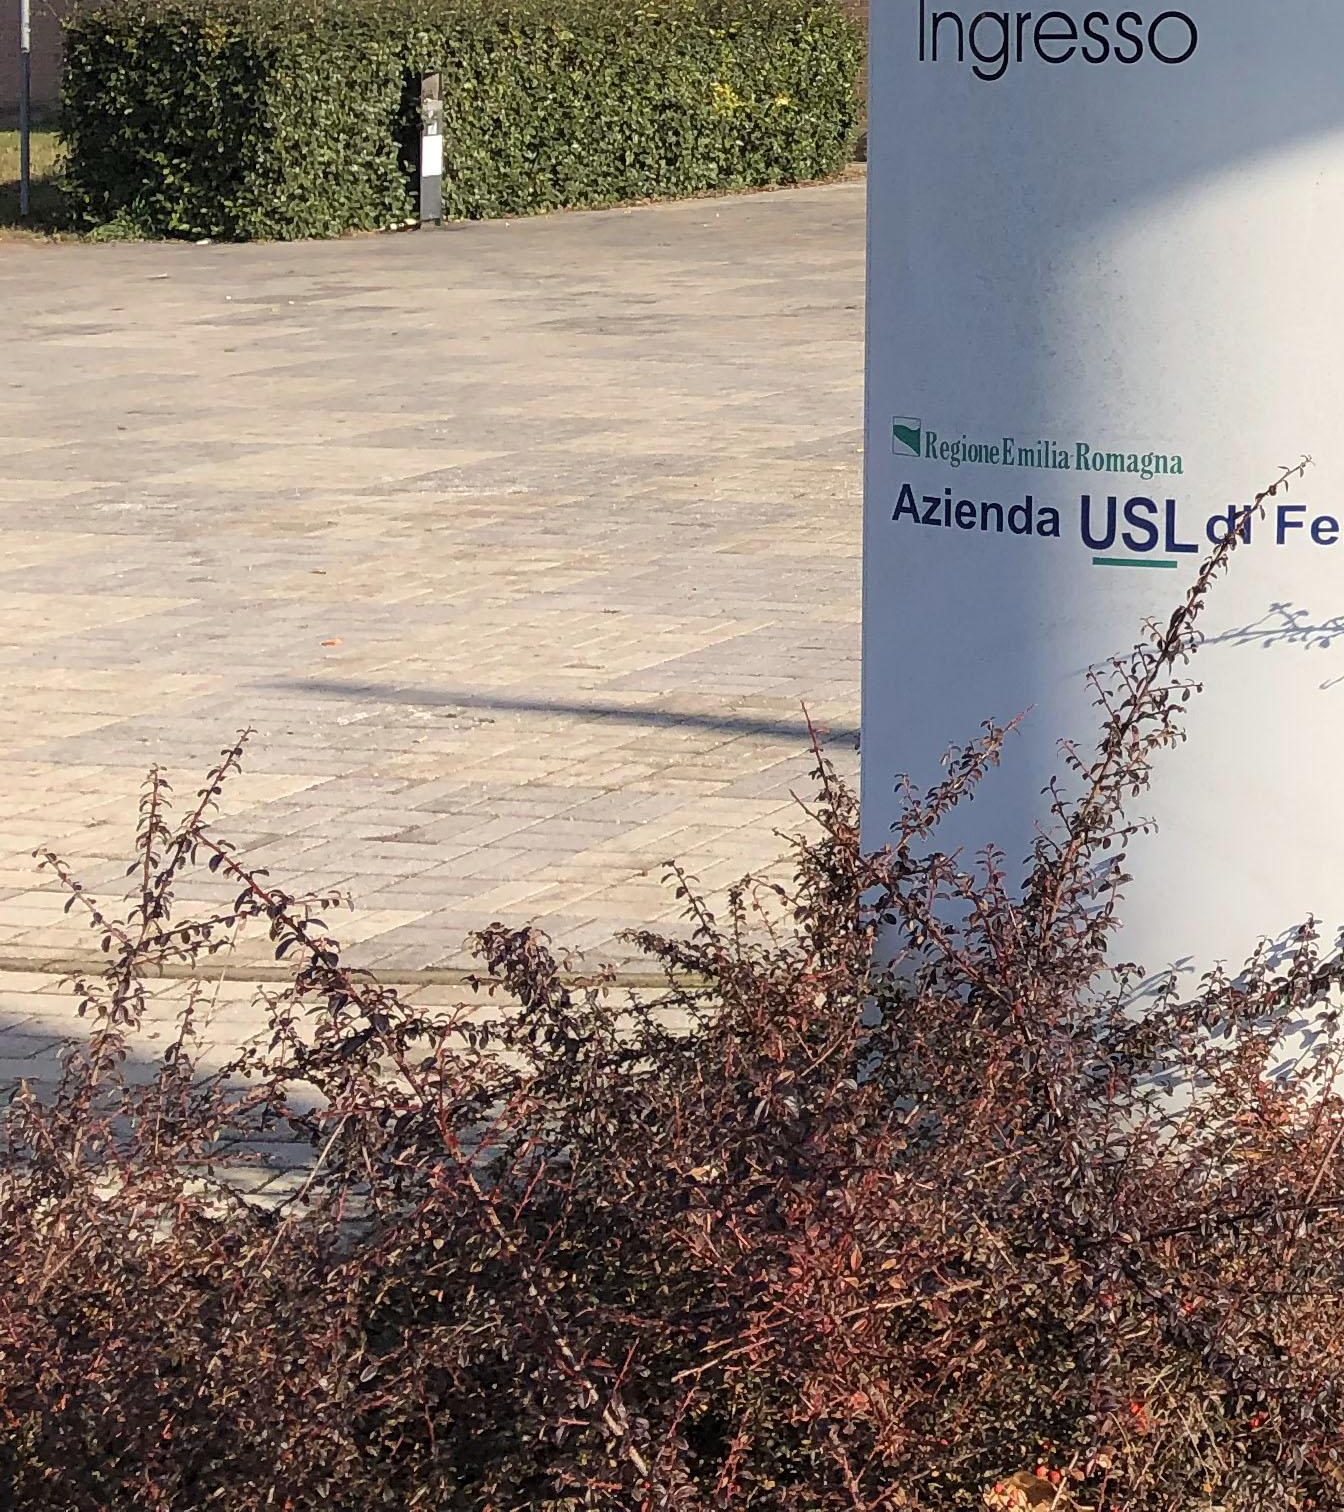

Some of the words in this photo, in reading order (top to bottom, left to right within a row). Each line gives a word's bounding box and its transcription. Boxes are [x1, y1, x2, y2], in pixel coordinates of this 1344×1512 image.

[891, 483, 1061, 538] Azienda
[1080, 494, 1200, 554] USL
[1205, 504, 1252, 546] di
